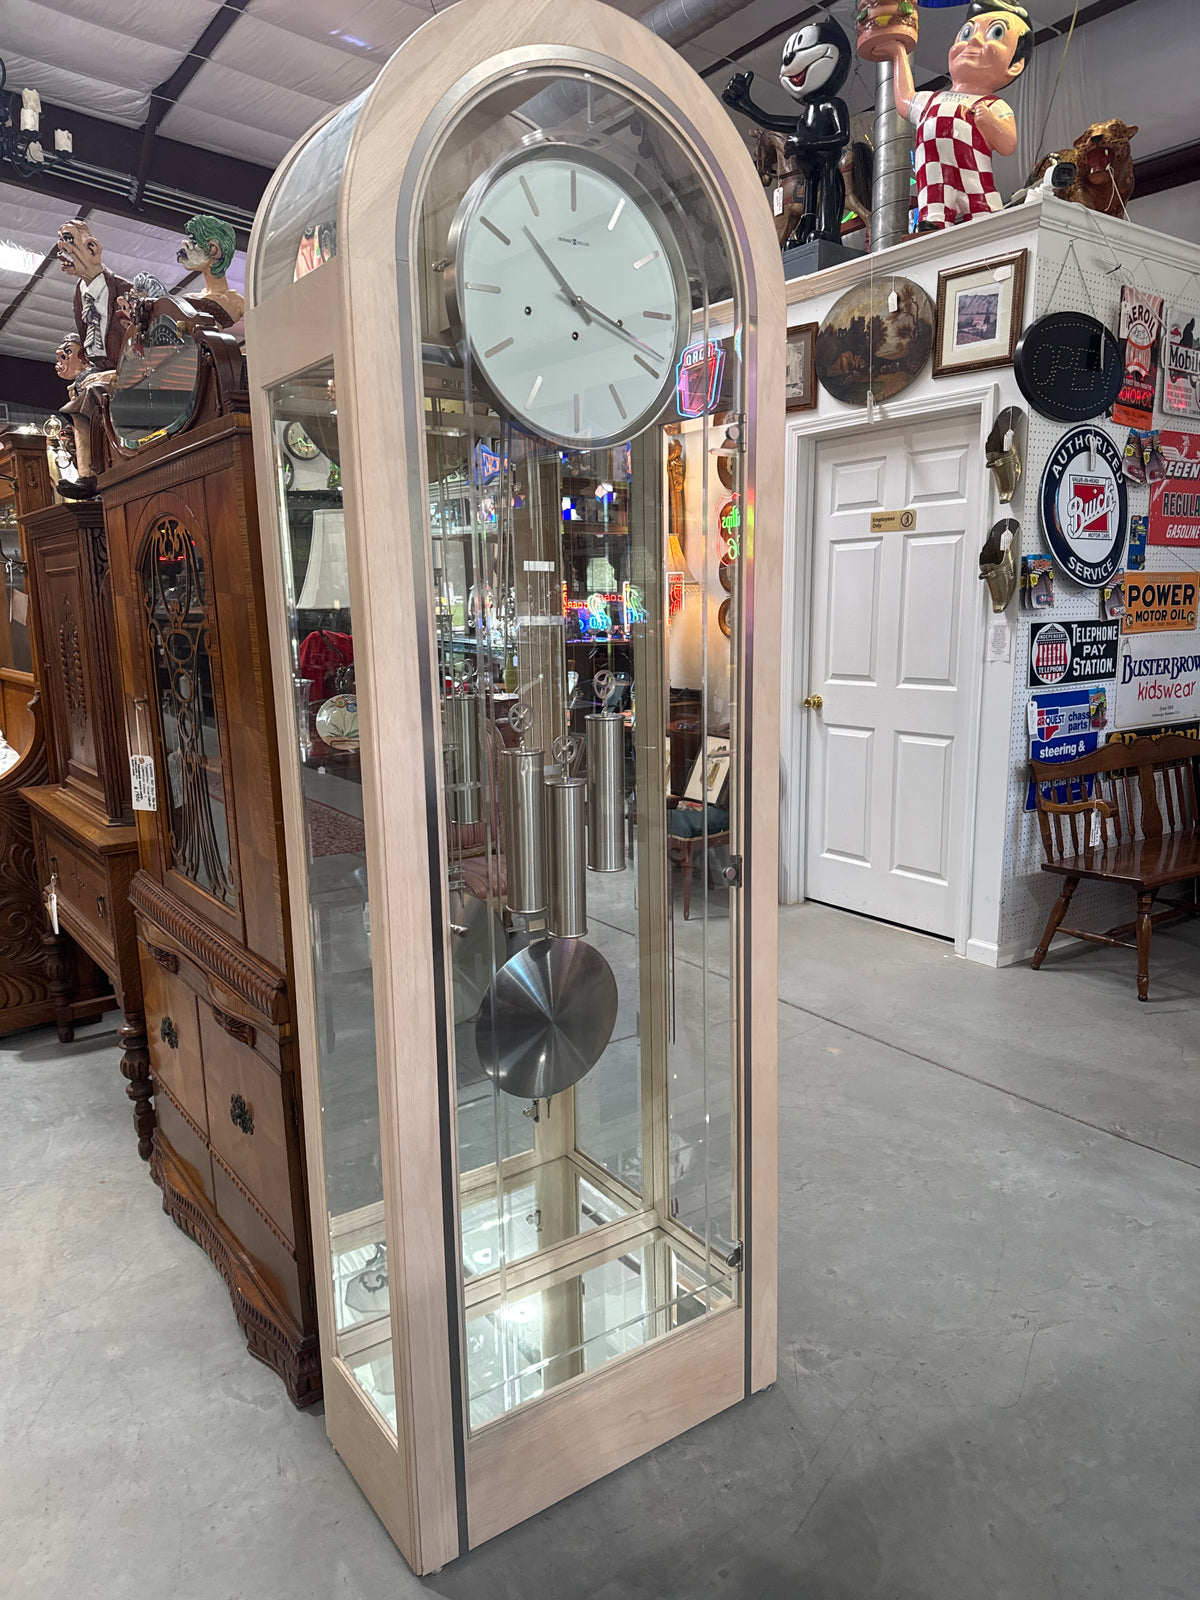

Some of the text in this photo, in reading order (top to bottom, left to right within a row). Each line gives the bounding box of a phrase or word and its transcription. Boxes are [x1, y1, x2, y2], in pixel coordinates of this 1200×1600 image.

[1032, 344, 1115, 391] OPEN
[1169, 344, 1200, 372] Mobil
[1052, 433, 1123, 485] AUTHORIZED
[1164, 460, 1200, 479] EGEN
[1067, 478, 1117, 540] Buick
[1166, 524, 1200, 539] GASOLINE
[1066, 556, 1113, 581] SERVICE
[1128, 584, 1195, 607] POWER
[1135, 609, 1186, 622] MOTOR OIL
[1071, 623, 1118, 646] TELEPHONE
[1083, 644, 1107, 657] PAY
[1038, 665, 1065, 673] TELEPHONE
[1072, 657, 1115, 676] STATION.
[1137, 680, 1196, 701] kidswear
[1068, 721, 1088, 733] parts
[1040, 740, 1085, 758] steering &
